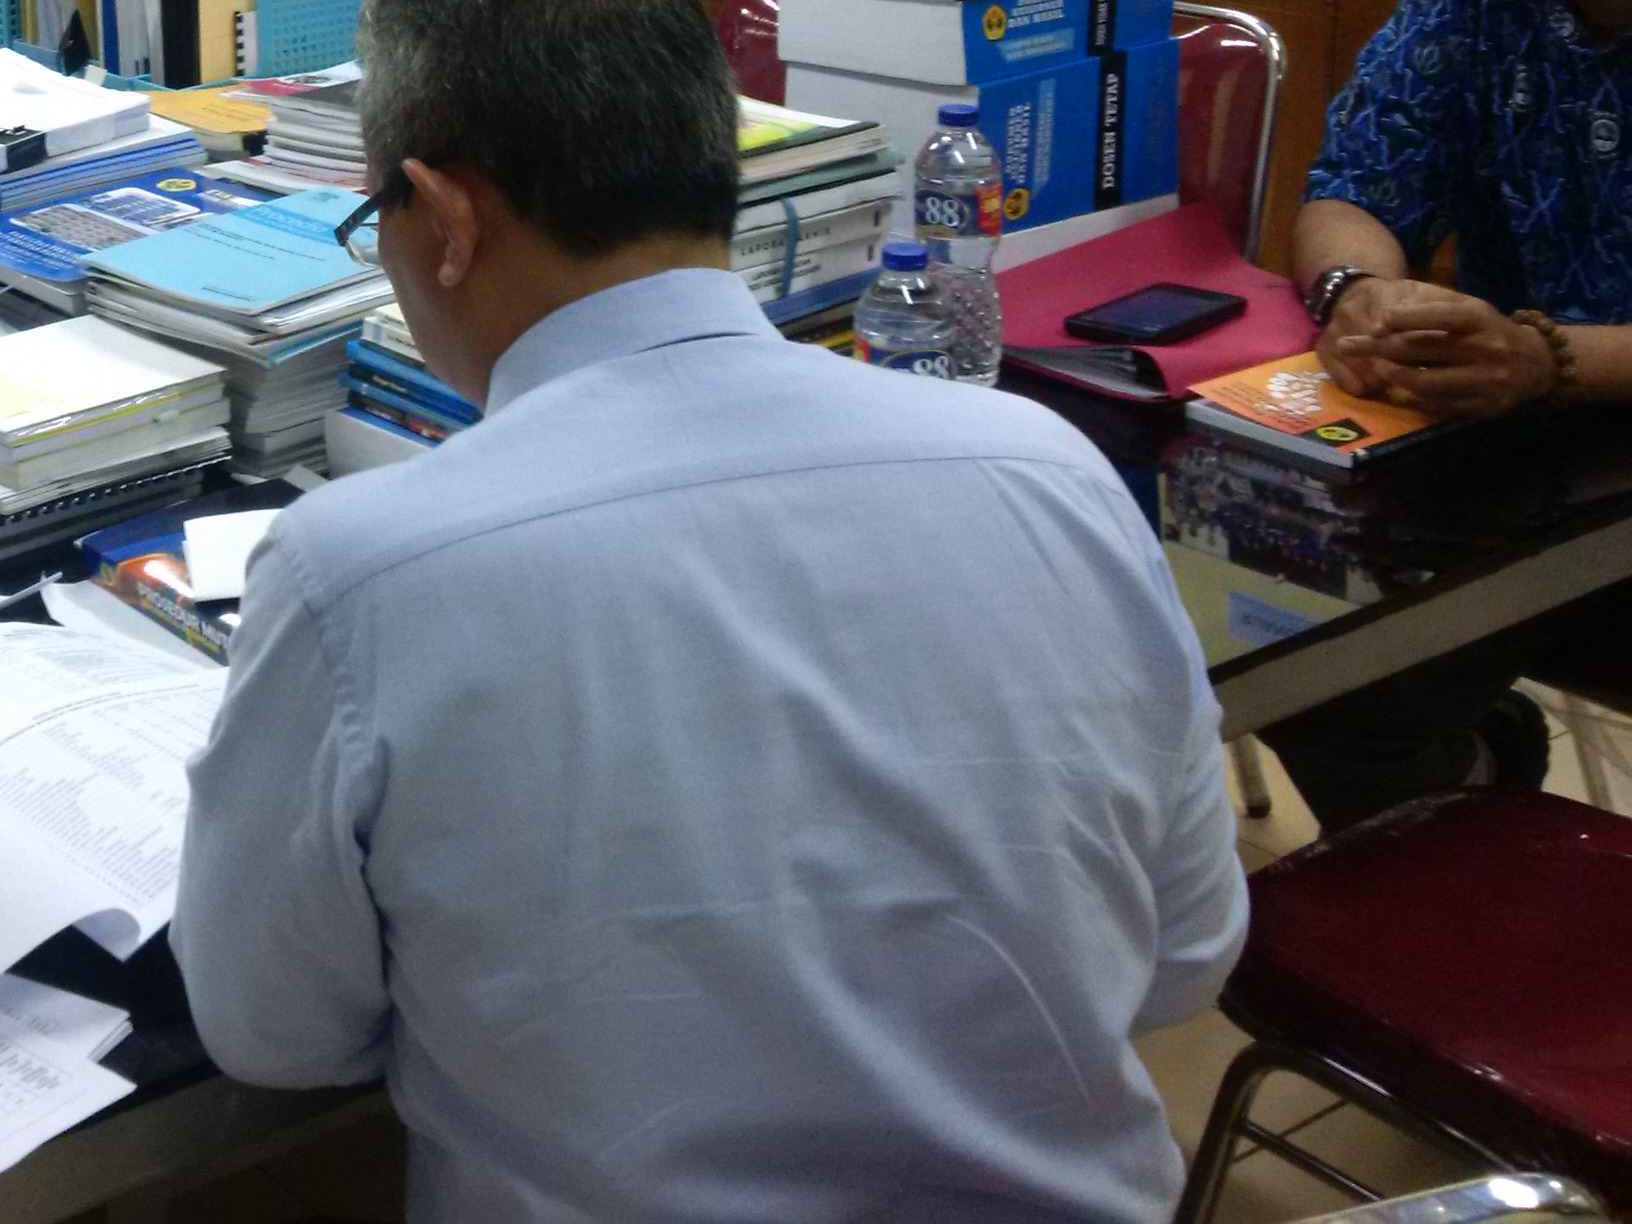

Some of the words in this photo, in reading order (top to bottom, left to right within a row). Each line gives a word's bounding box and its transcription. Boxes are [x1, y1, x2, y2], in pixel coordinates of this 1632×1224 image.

[1103, 73, 1119, 127] TETAP
[1102, 131, 1117, 190] DOSEN
[926, 196, 961, 227] 88
[740, 239, 785, 256] LAPORA
